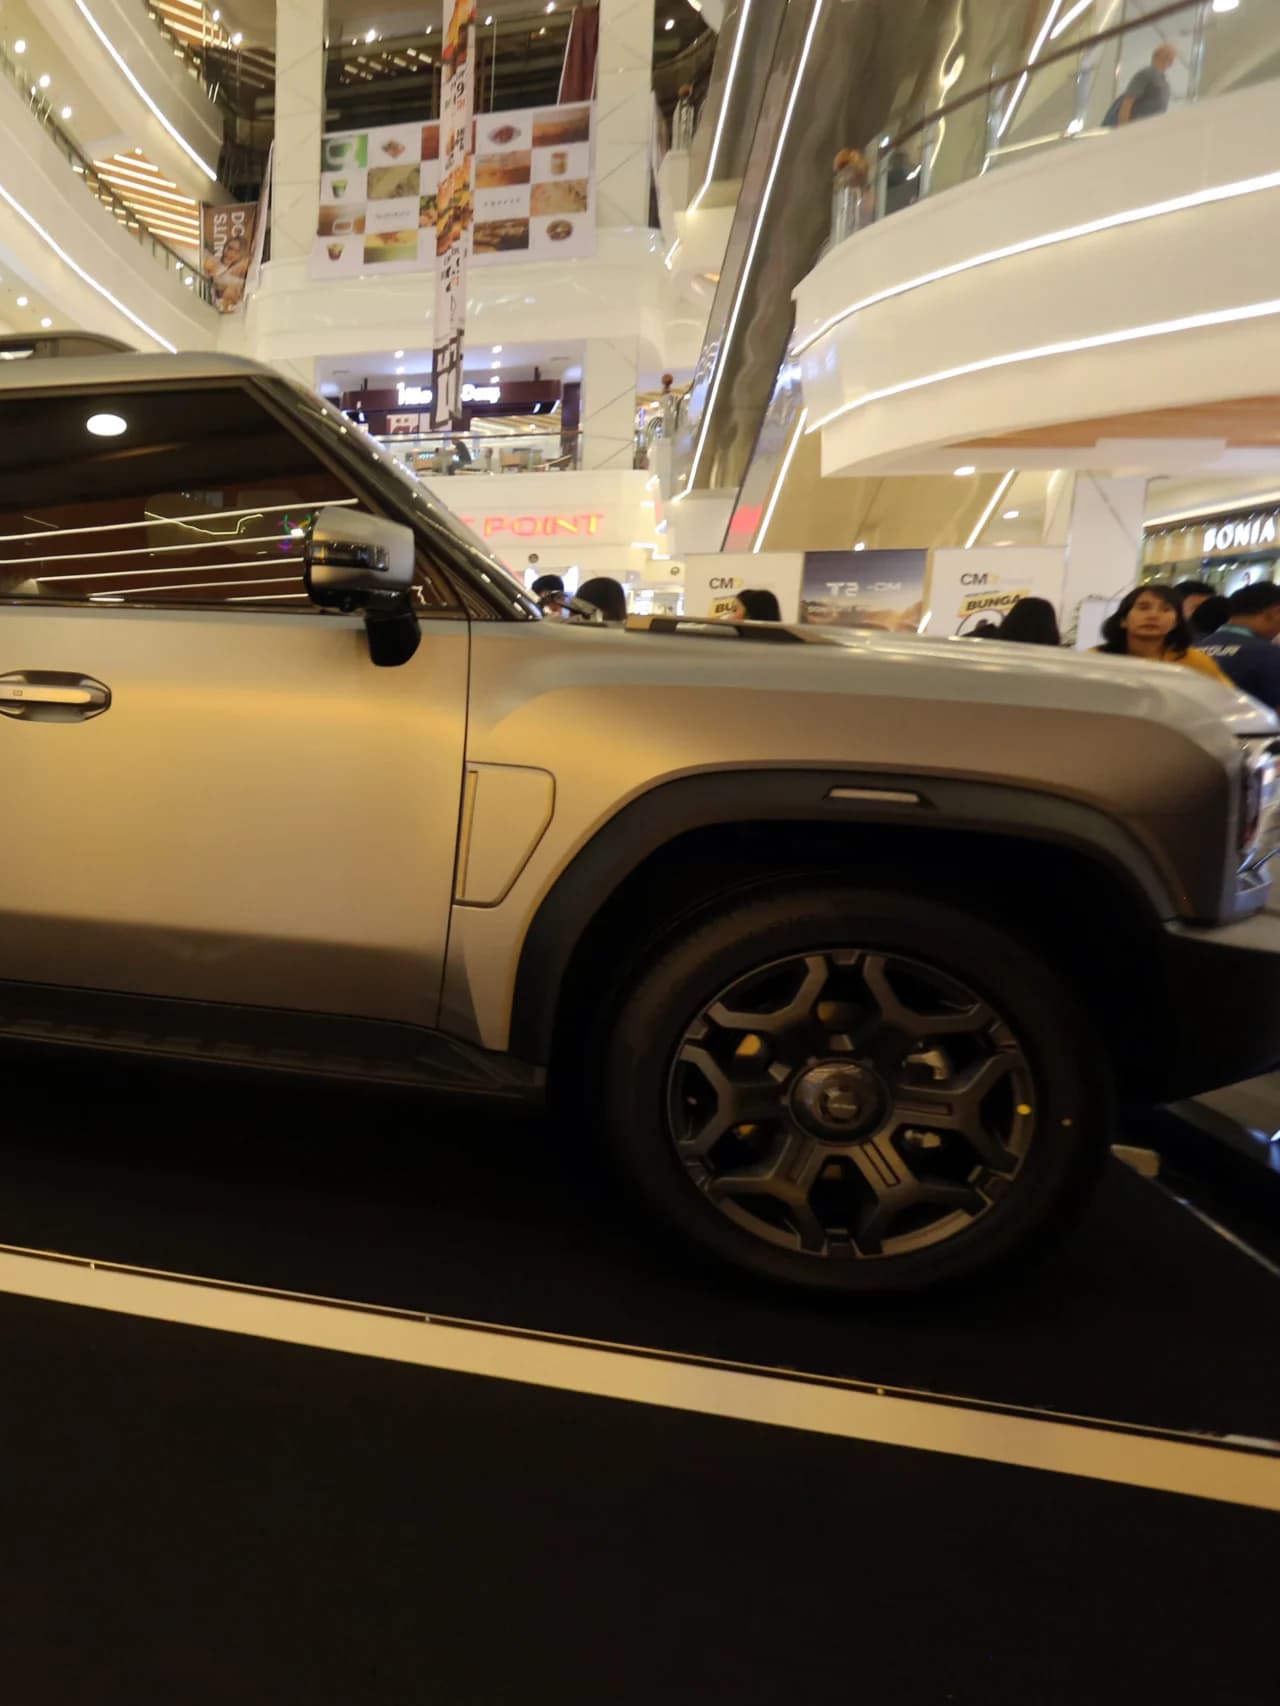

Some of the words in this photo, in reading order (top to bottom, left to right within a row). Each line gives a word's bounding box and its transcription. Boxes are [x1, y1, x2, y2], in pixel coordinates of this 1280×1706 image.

[483, 513, 604, 537] POINT
[1203, 516, 1276, 552] BONIA
[966, 594, 1021, 611] BUNGA
